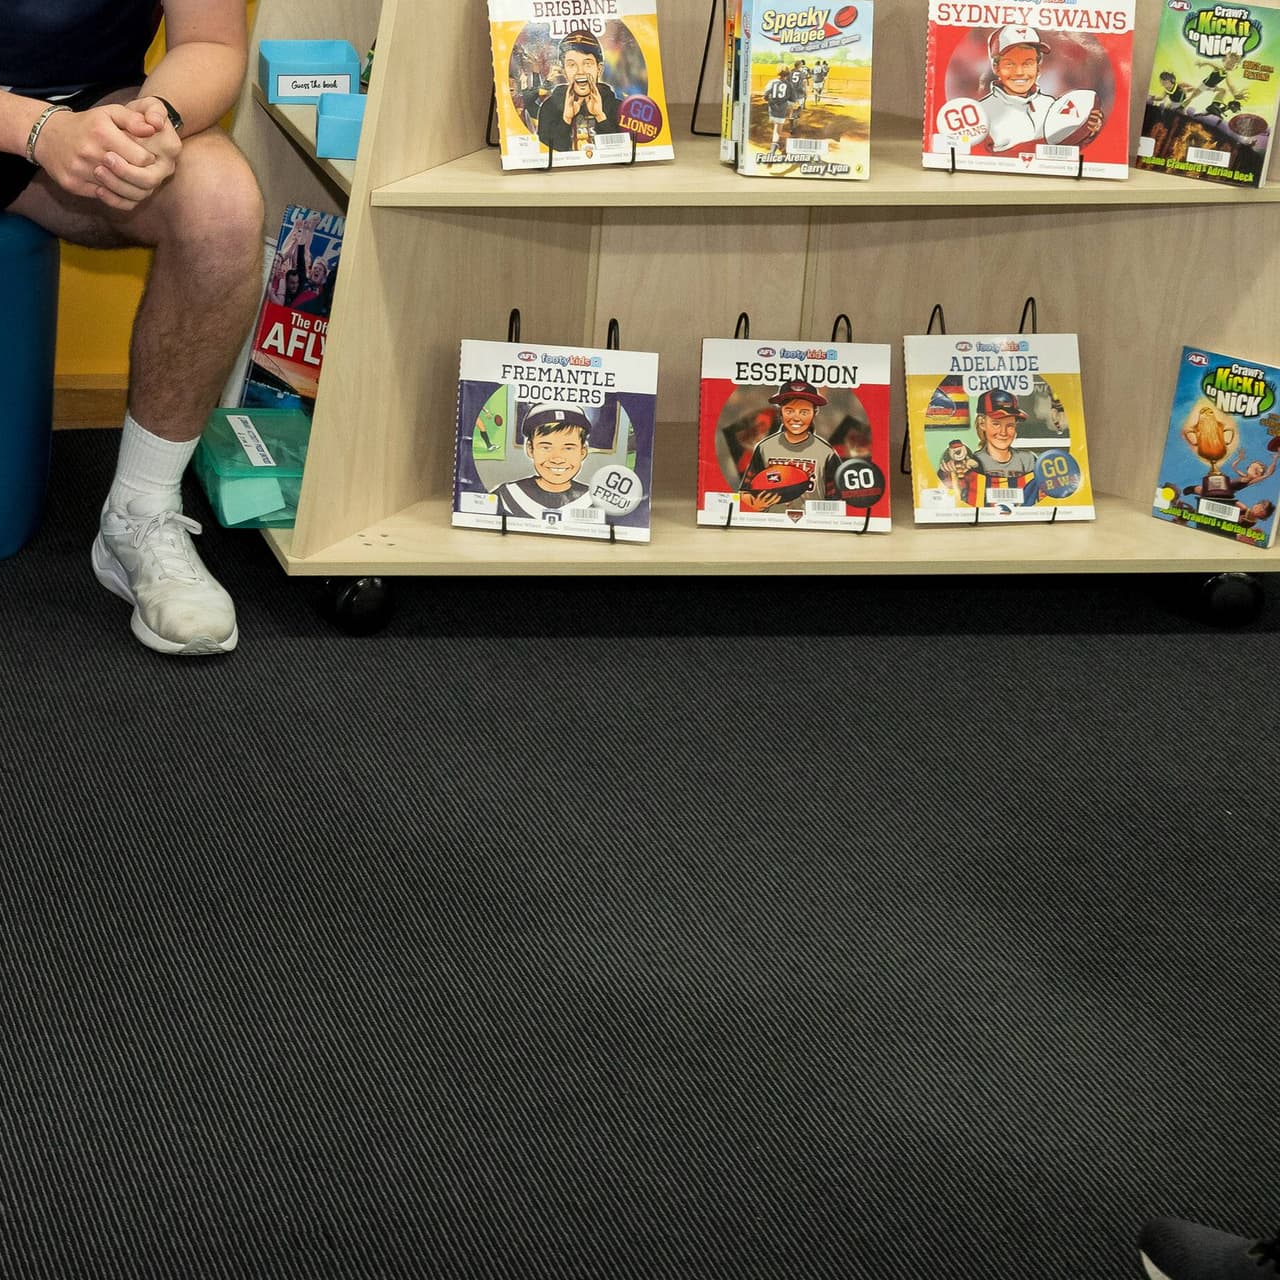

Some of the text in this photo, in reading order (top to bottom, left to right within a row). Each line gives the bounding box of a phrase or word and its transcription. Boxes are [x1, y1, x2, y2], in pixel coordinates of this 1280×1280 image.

[1169, 0, 1191, 11] AFL
[762, 6, 830, 33] Specky
[937, 3, 1128, 30] SYDNEY SWANS
[552, 18, 603, 36] LIONS
[1188, 30, 1200, 41] to
[780, 29, 826, 45] Magee
[291, 79, 338, 90] Guess book
[791, 71, 800, 84] 5
[772, 82, 788, 99] 19
[629, 101, 654, 122] GO
[944, 104, 980, 131] GO
[619, 114, 658, 139] LIONS!
[756, 152, 811, 163] Felice Arena
[800, 162, 849, 174] Garry Lyon
[1166, 158, 1255, 182] Crawford Adrian Beck
[290, 311, 310, 329] The
[261, 322, 320, 367] AFL
[950, 356, 1040, 372] ADELAIDE
[1187, 353, 1209, 366] AFL
[501, 364, 616, 388] FREMANTLE
[735, 362, 859, 384] ESSENDON
[967, 375, 1029, 391] CROWS
[1205, 384, 1217, 398] to
[518, 384, 602, 404] DOCKERS
[1041, 456, 1068, 477] GO
[605, 471, 634, 495] GO
[843, 468, 876, 490] GO
[592, 485, 631, 512] FREO!
[1221, 521, 1246, 536] Adrian
